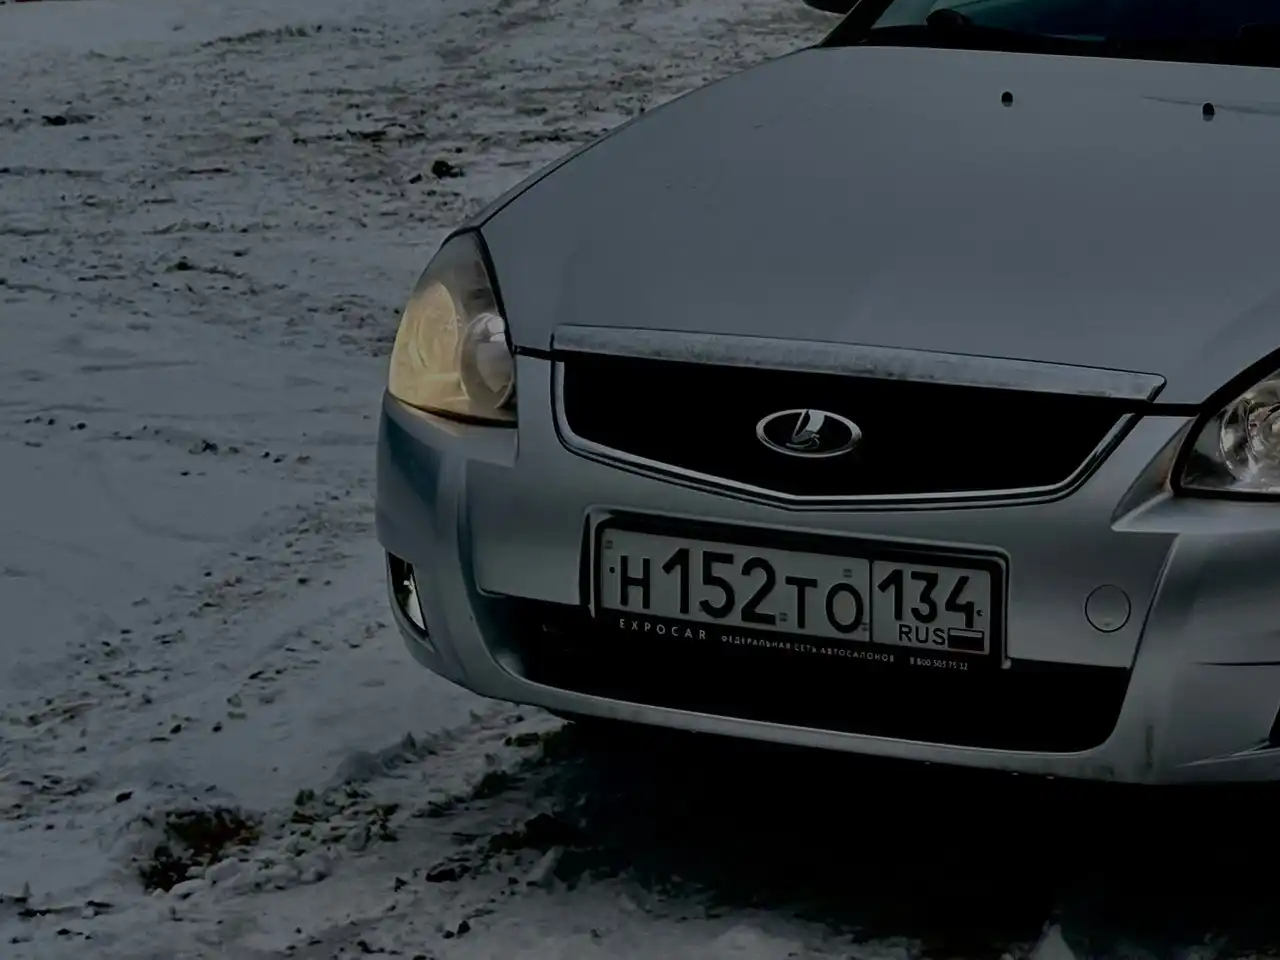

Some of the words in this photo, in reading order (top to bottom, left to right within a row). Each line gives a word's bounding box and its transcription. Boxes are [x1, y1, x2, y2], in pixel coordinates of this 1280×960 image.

[620, 548, 864, 633] Н152ТО
[878, 570, 975, 628] 134
[619, 618, 706, 640] EXPOCAR
[899, 623, 946, 646] RUS
[721, 634, 791, 649] ФЕДЕРАЛЬНАЯ
[794, 643, 817, 653] СЕТЬ
[820, 647, 895, 663] АВТОСАЛОНОВ
